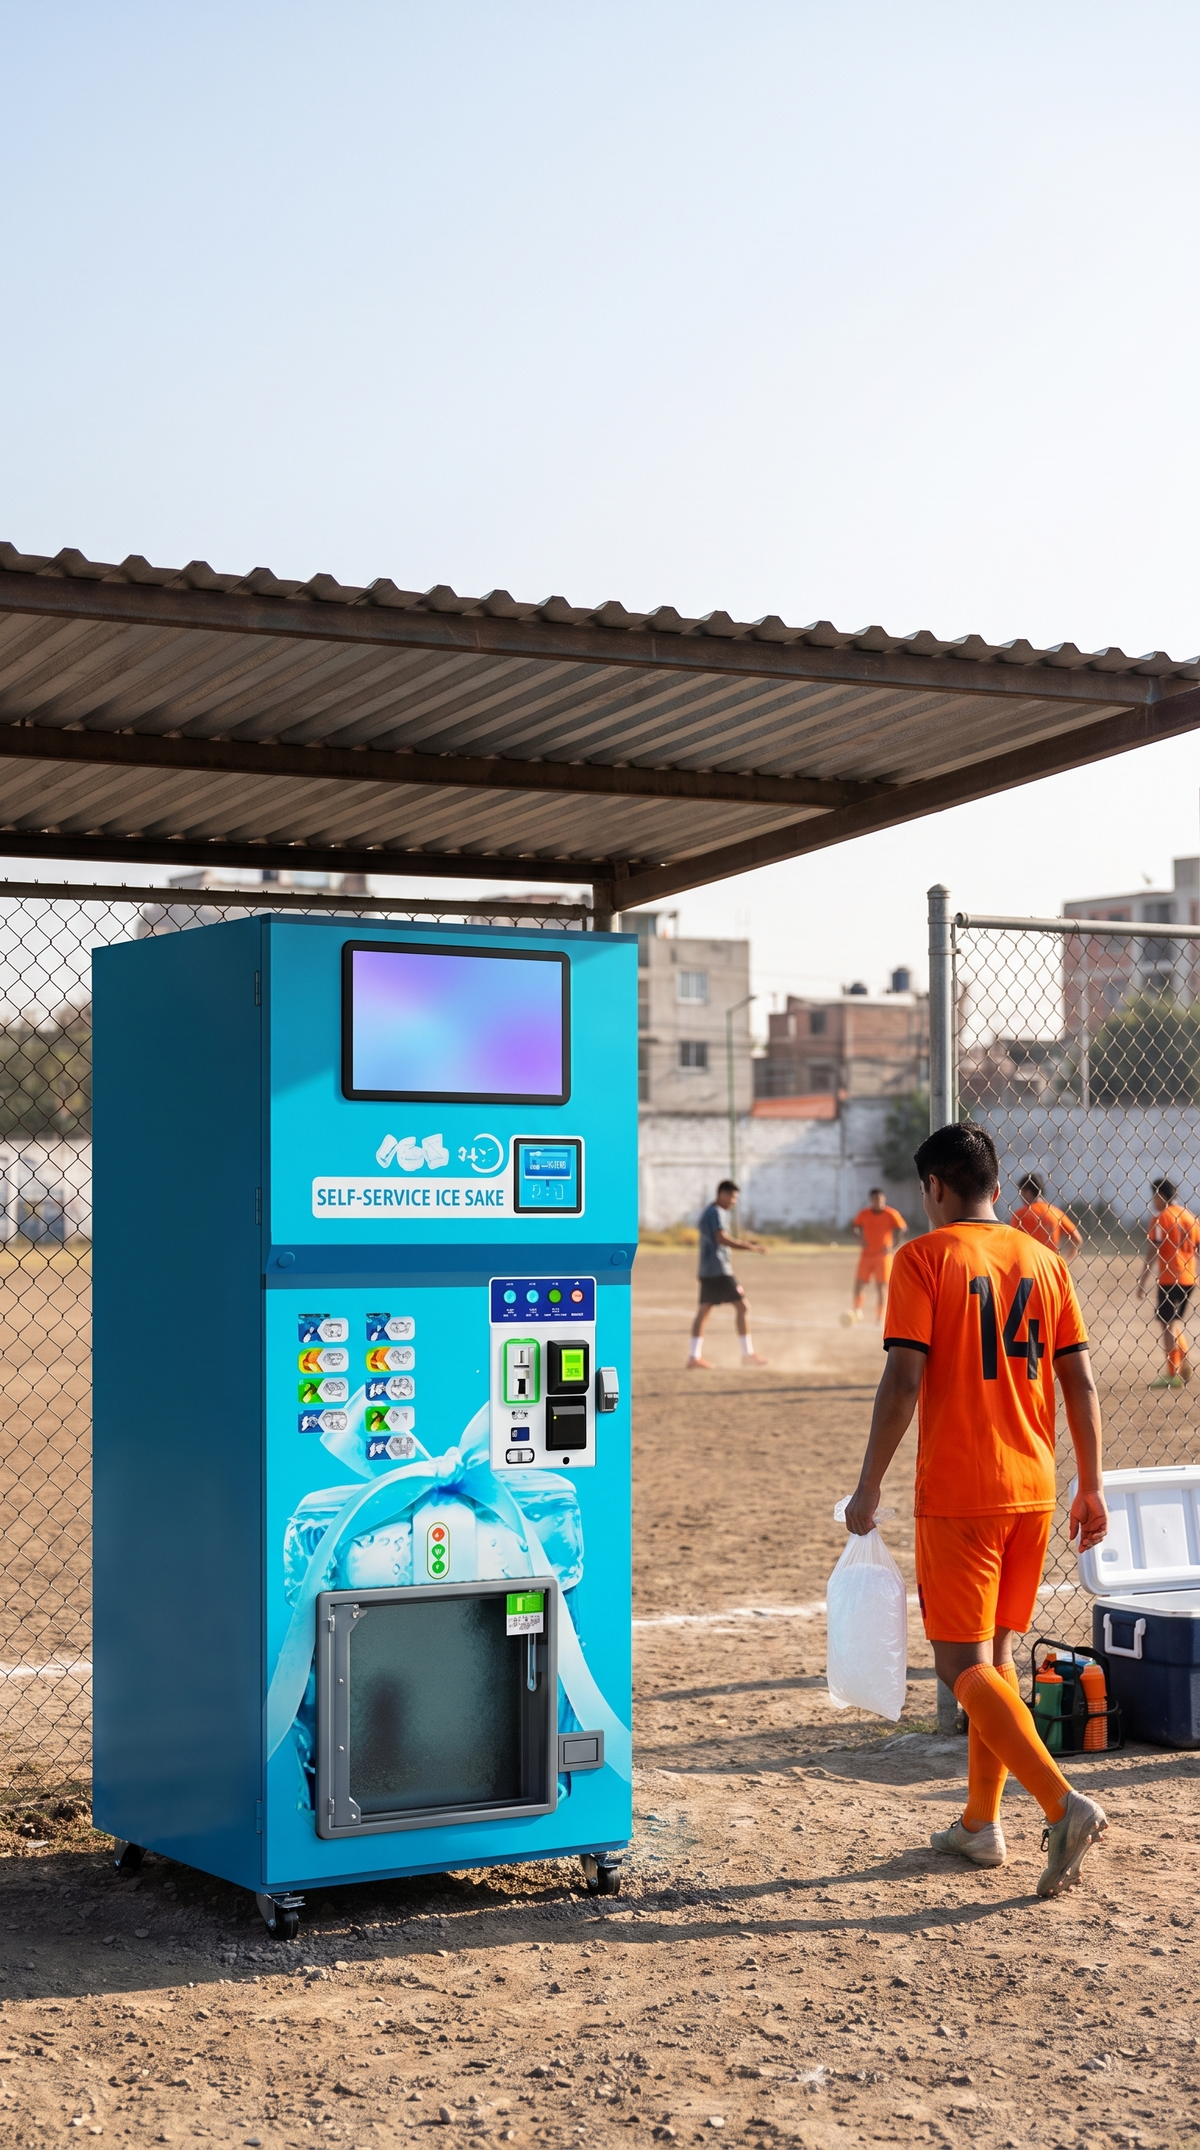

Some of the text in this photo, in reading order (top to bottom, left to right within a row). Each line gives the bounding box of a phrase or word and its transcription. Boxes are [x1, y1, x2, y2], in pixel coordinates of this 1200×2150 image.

[317, 1188, 504, 1206] SELF-SERVICE ICE SAKE
[969, 1276, 1045, 1380] 14
